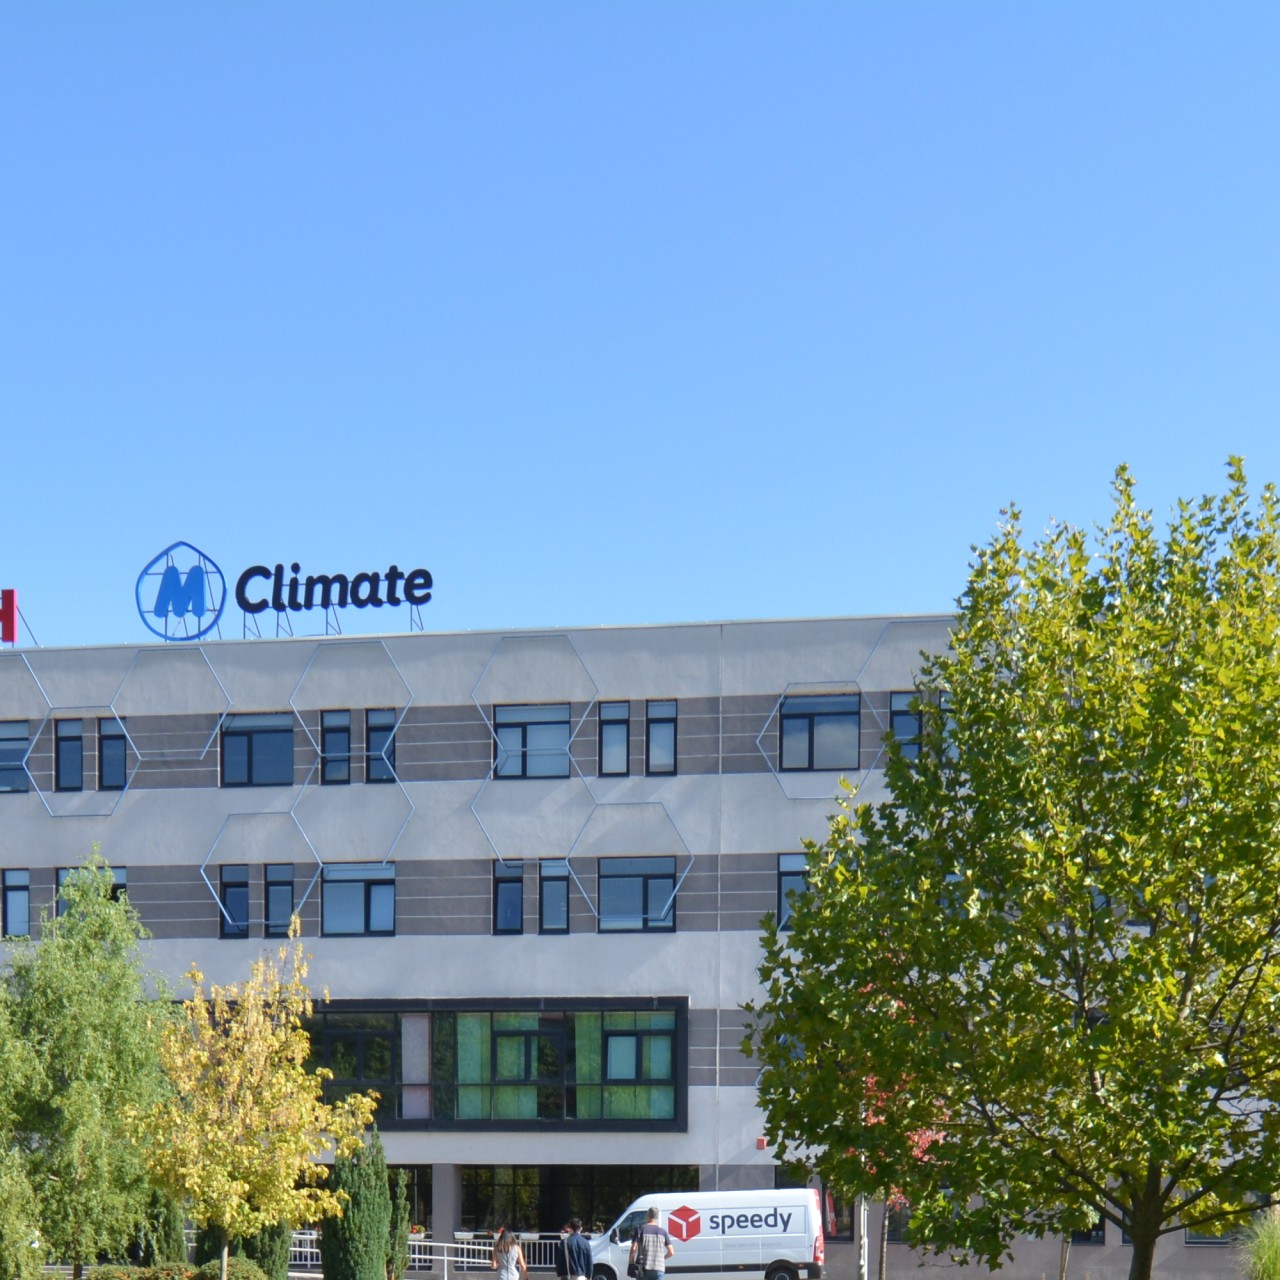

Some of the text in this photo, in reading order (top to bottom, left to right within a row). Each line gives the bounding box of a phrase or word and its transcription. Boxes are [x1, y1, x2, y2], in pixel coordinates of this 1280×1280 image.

[154, 562, 433, 618] M Climate
[709, 1207, 792, 1235] speedy
